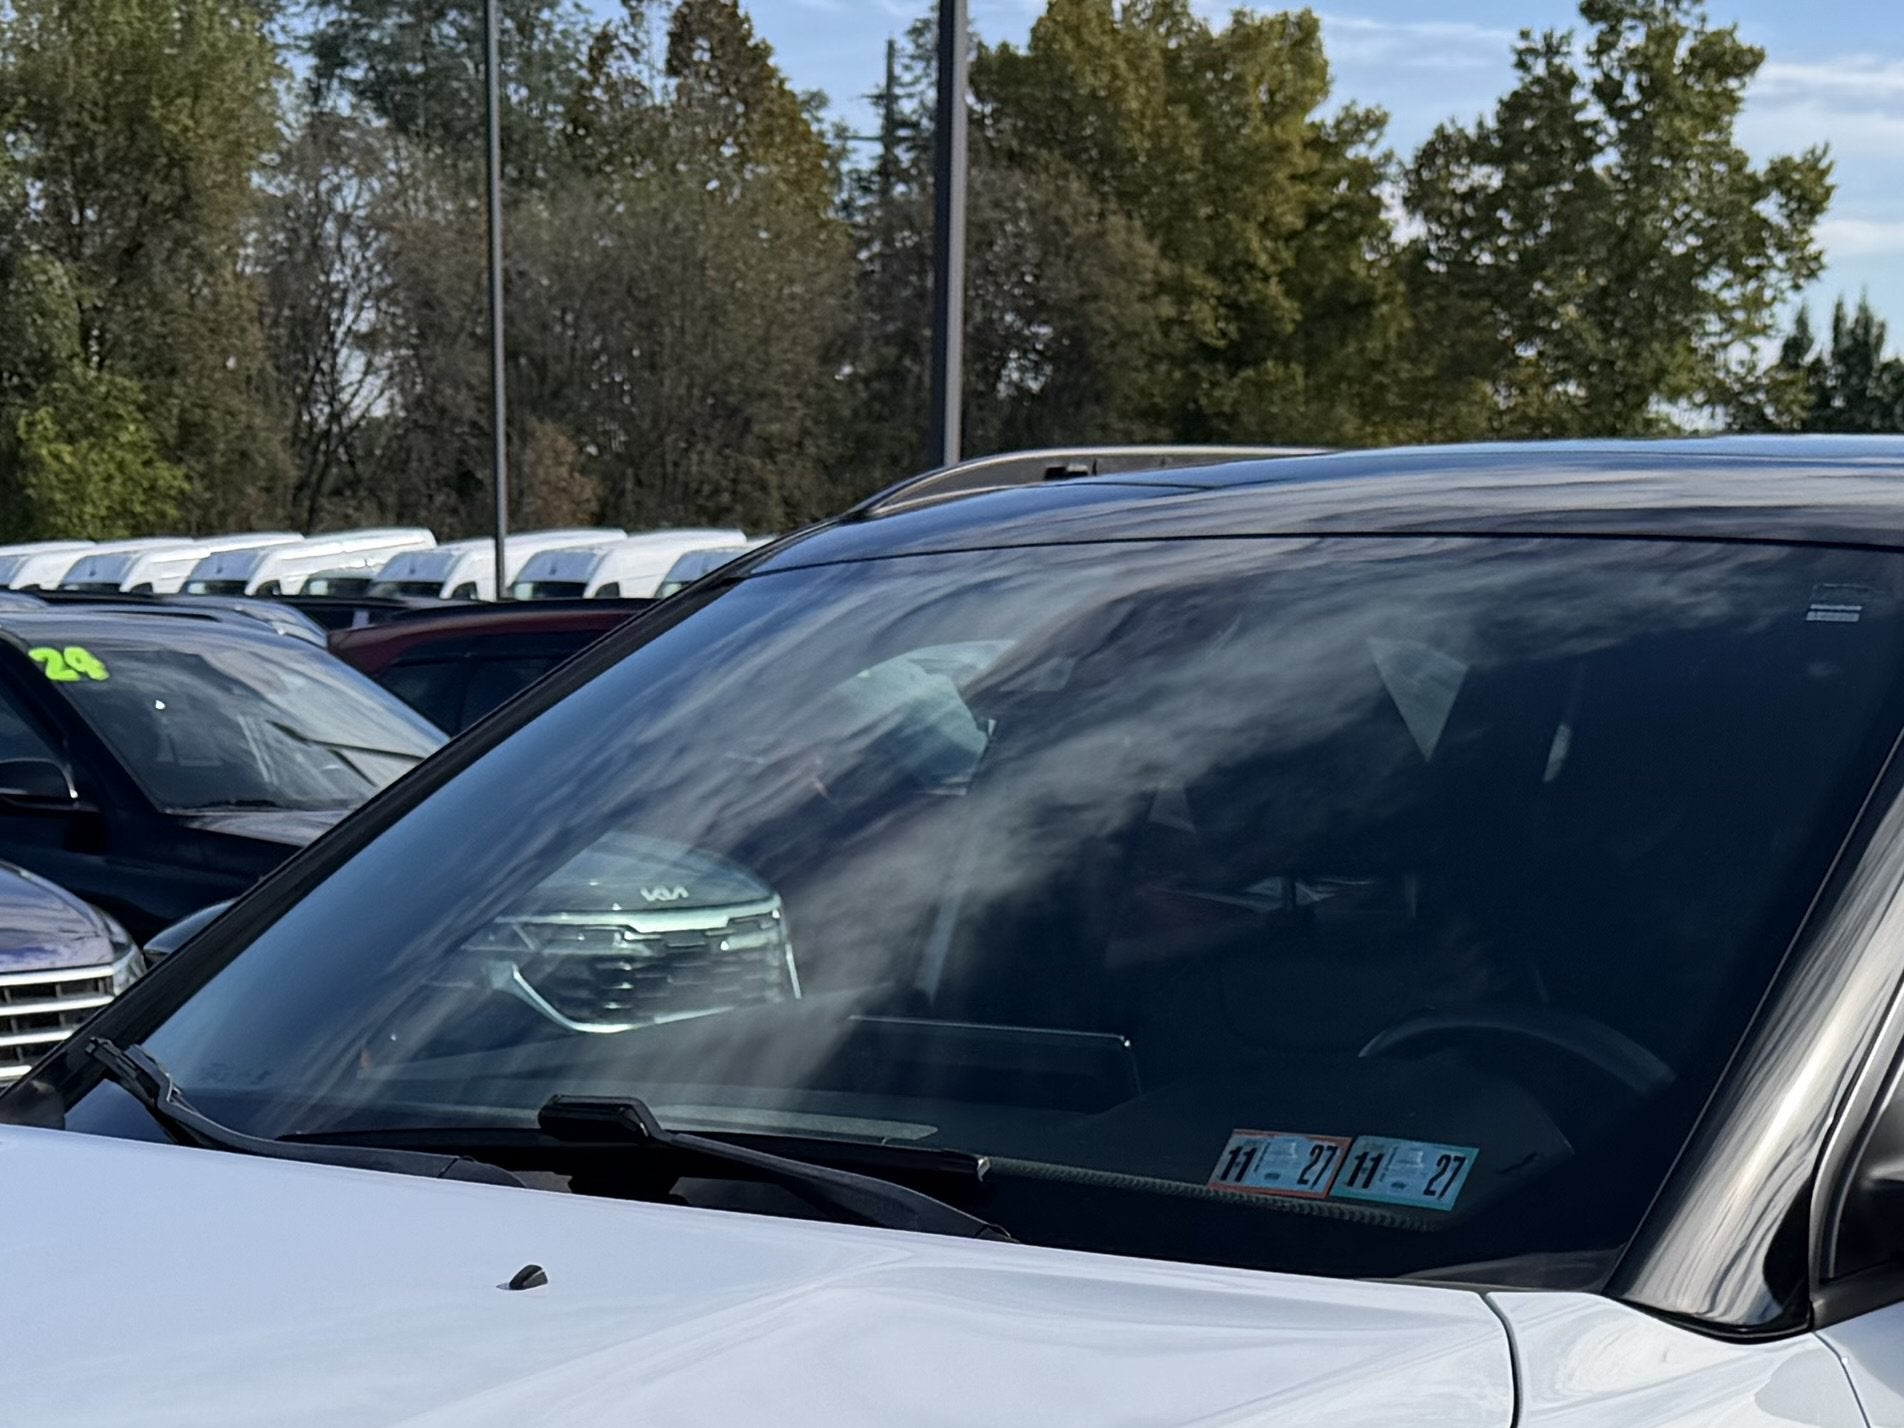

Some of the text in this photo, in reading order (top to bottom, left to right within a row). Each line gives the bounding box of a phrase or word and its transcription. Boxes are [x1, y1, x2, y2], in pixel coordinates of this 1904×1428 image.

[1220, 1145, 1258, 1183] 11
[1296, 1144, 1339, 1190] 27
[1346, 1151, 1385, 1190] 11
[1422, 1153, 1467, 1200] 27
